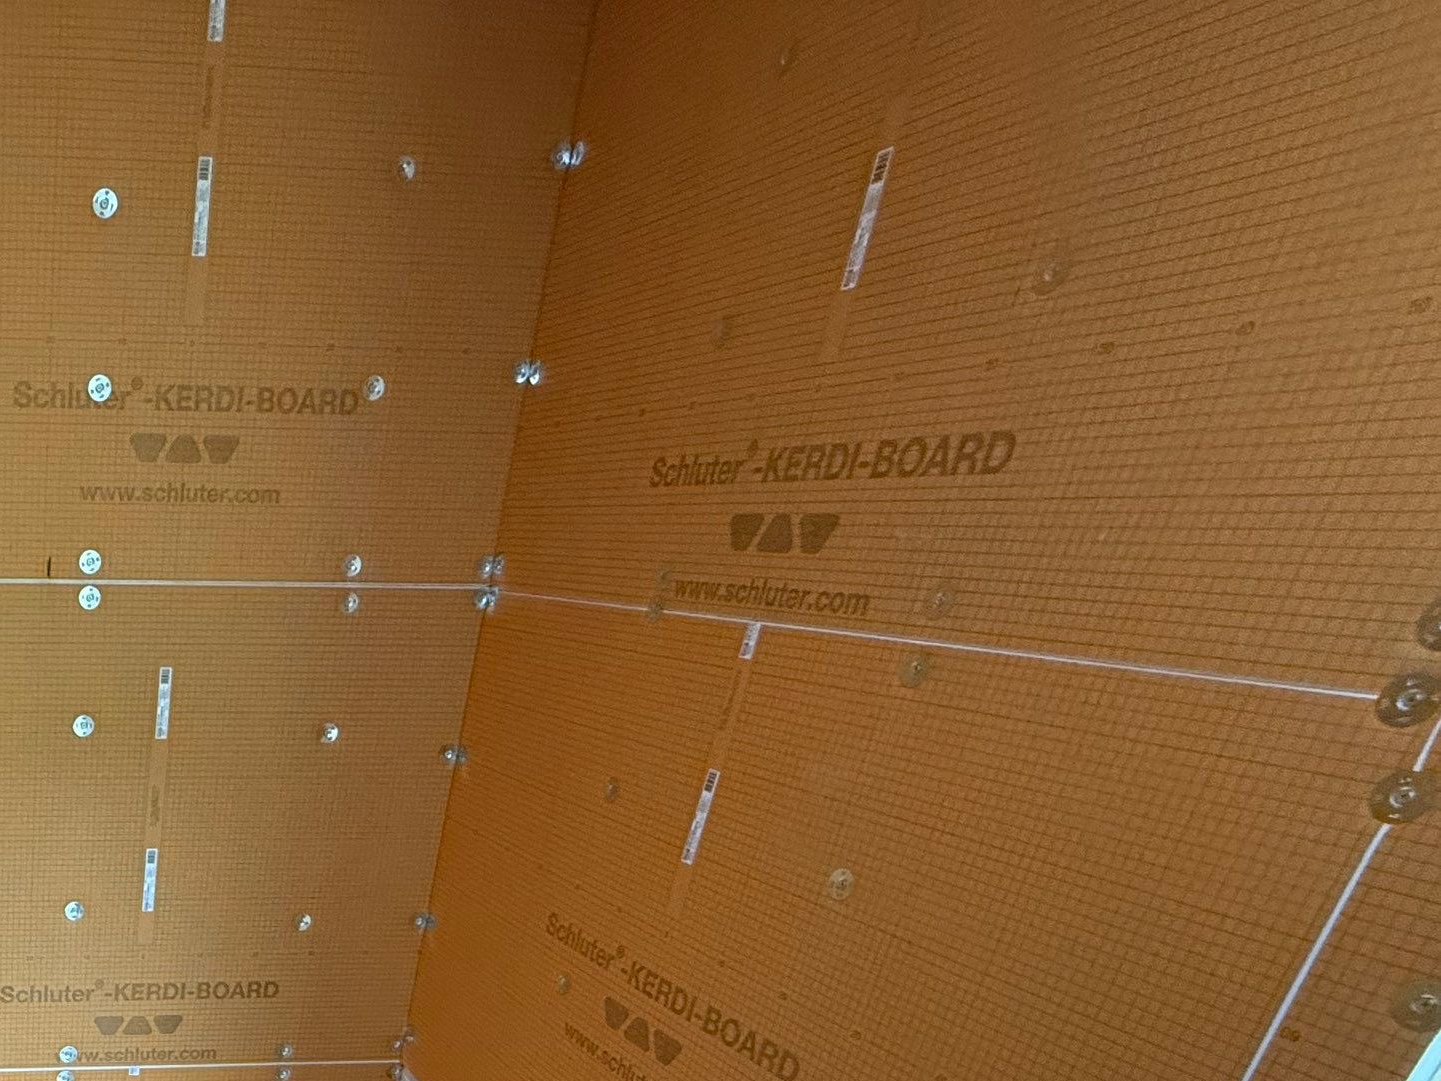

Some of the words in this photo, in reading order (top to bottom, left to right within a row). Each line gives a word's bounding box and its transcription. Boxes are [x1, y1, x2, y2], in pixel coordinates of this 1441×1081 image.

[79, 482, 281, 505] www.schluter.com
[673, 578, 872, 616] www.schluter.com
[58, 1047, 217, 1062] ww.schluter.com
